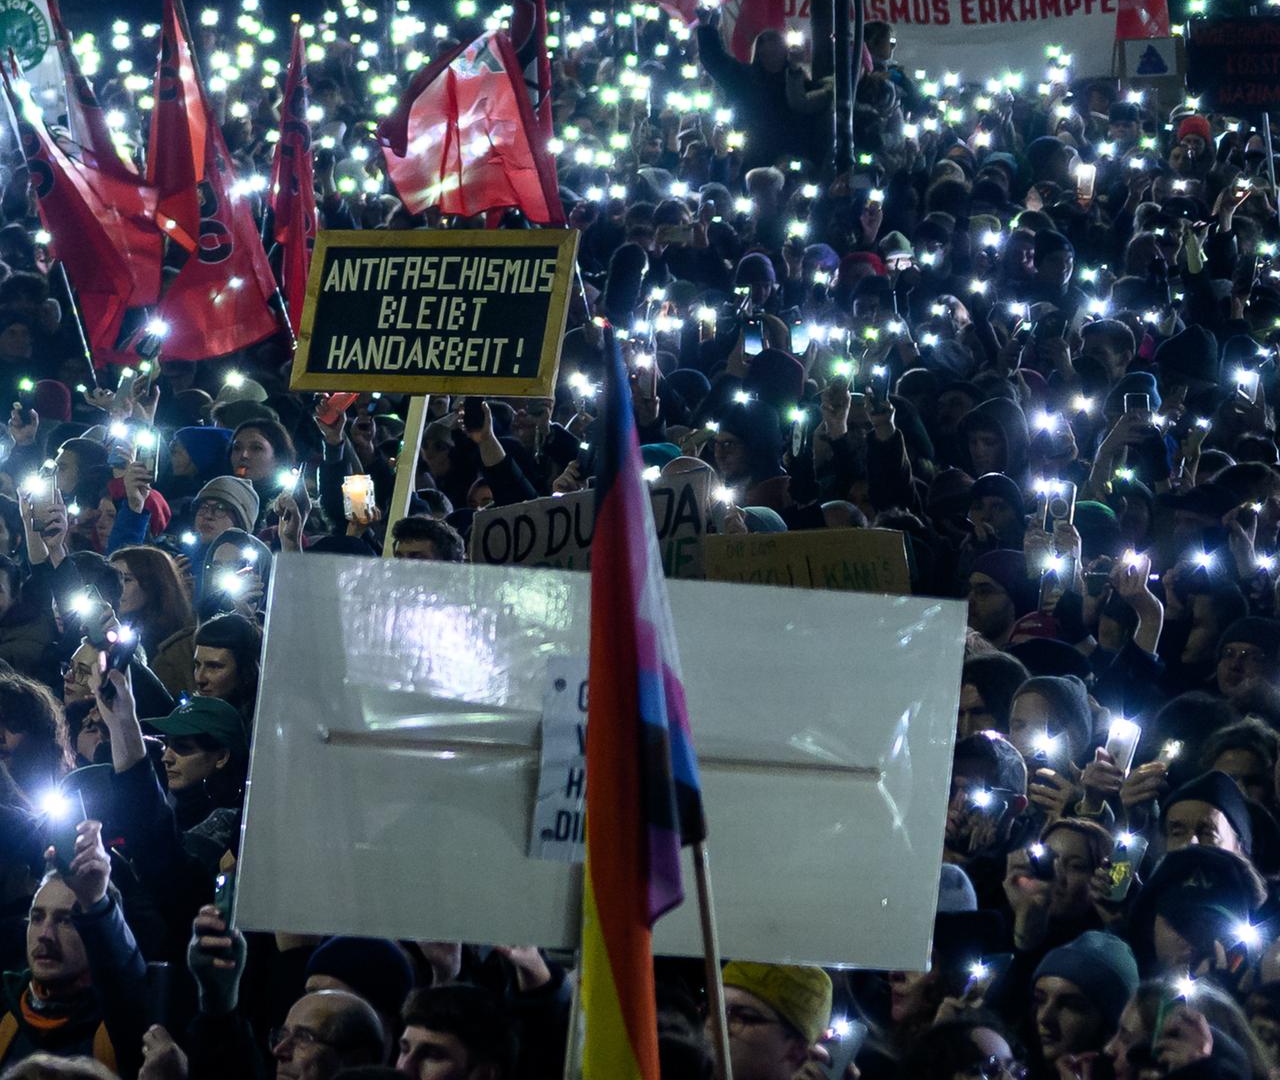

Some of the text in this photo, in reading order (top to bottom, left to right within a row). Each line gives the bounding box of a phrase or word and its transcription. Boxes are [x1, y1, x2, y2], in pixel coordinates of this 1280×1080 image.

[324, 256, 557, 294] ANTIFASCHISMUS
[377, 296, 487, 331] BLEIBT
[482, 514, 536, 565] OD
